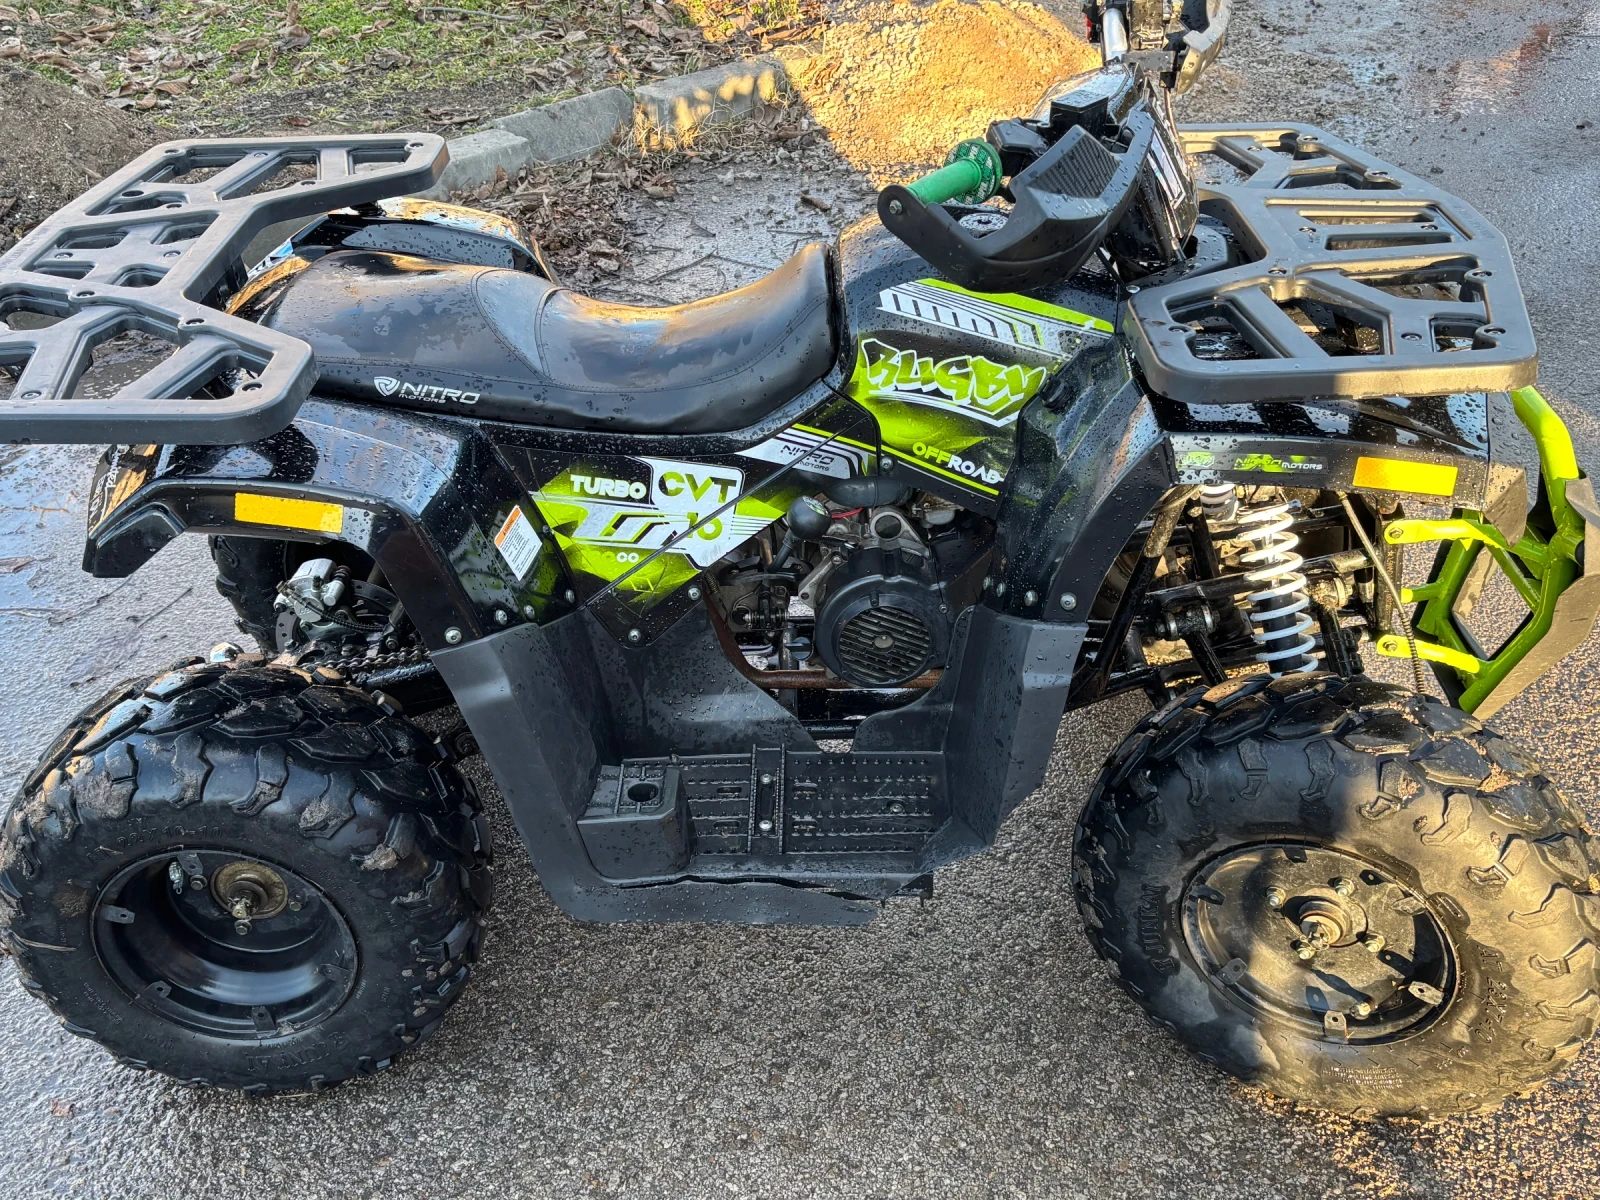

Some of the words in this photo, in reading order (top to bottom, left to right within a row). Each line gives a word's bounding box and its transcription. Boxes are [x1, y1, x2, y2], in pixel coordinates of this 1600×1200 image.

[860, 338, 1048, 408] RUGBY
[399, 393, 446, 404] MOTORS
[400, 381, 480, 404] NITRO
[1281, 462, 1323, 470] MOTORS
[570, 474, 647, 499] TURBO
[658, 471, 738, 503] CVT
